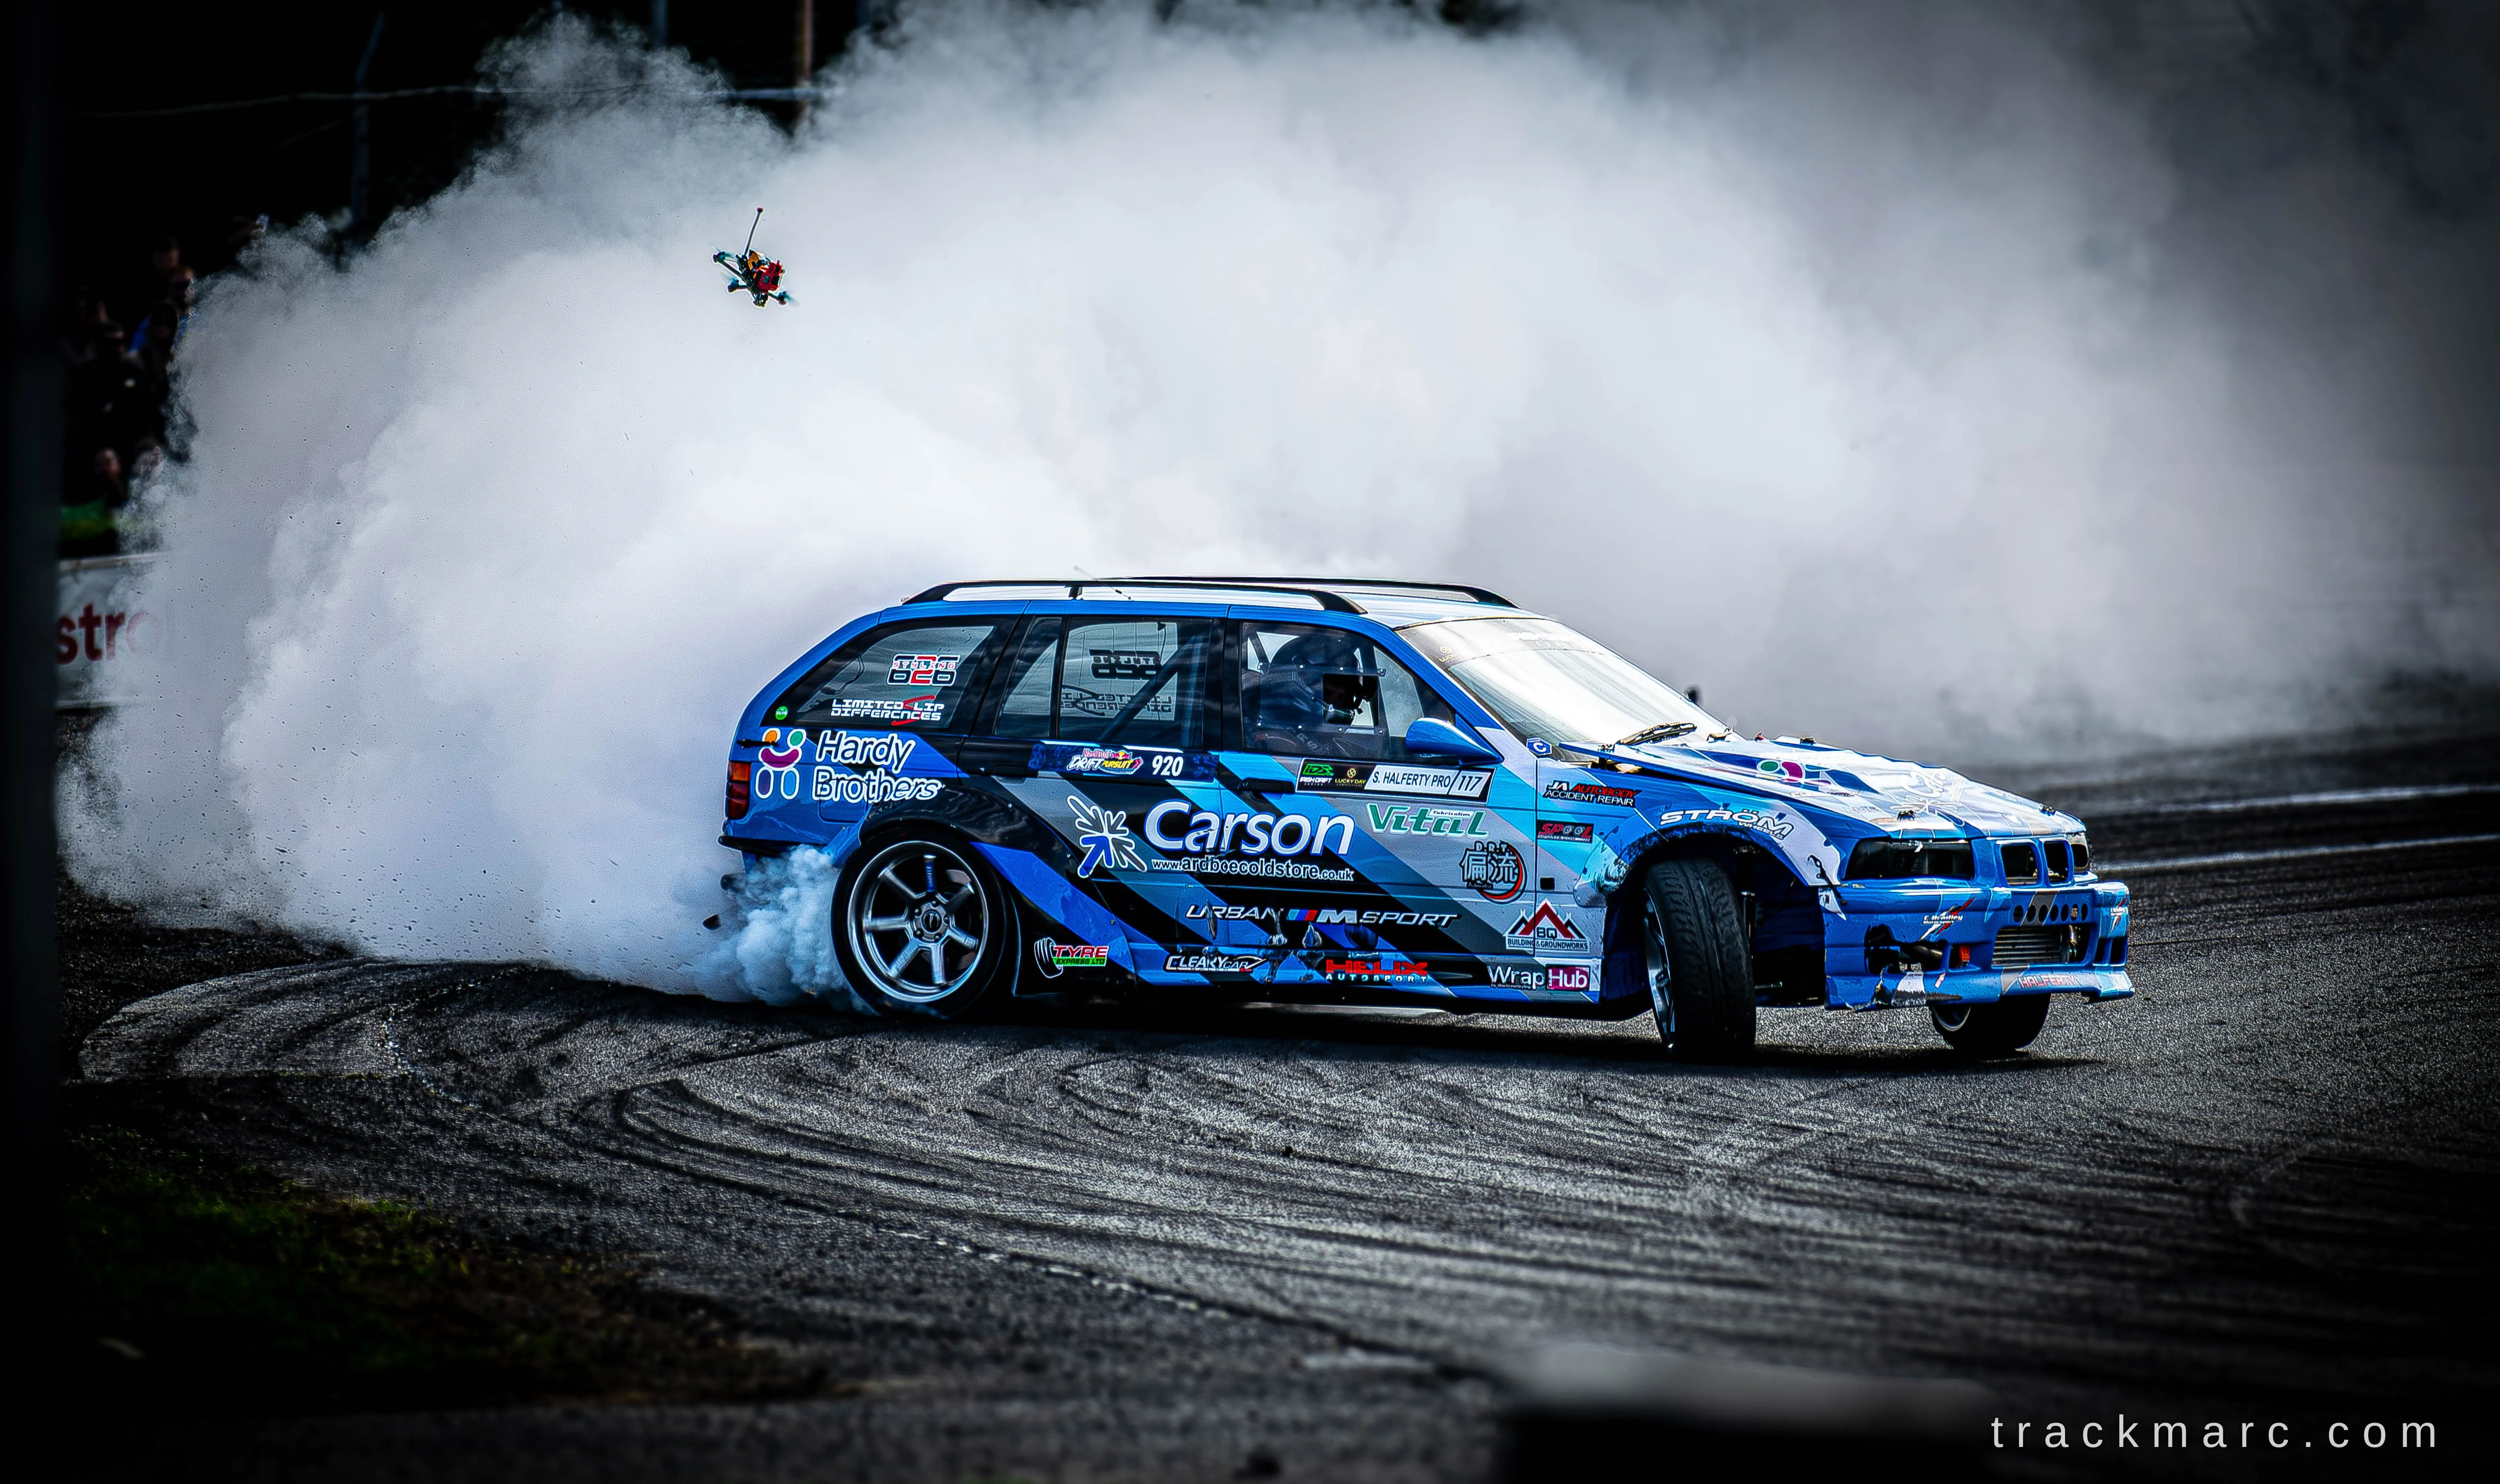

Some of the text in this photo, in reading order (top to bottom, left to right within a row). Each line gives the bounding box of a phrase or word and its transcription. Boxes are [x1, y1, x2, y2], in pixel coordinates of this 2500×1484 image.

[891, 661, 956, 670] STYLING
[832, 699, 904, 710] LIMITED
[816, 730, 916, 773] Hardy
[1068, 756, 1134, 770] DRIFT PURSUIT
[1152, 755, 1183, 776] 920
[812, 766, 943, 803] Brothers
[1372, 771, 1451, 788] S. HALFERTY PRO
[1458, 775, 1483, 792] 117
[1545, 790, 1634, 806] ACCIDENT REPAIR
[1548, 782, 1638, 798] JA AUTOBODY
[1144, 800, 1355, 856] Carson
[1367, 803, 1490, 839] Vital
[1660, 808, 1794, 836] STRÖM
[1539, 823, 1592, 839] SPOOL
[1739, 822, 1784, 840] WHEELS
[1151, 856, 1355, 881] www.ardboecoldstore.co.uk
[1461, 850, 1518, 882] 偏流
[1186, 904, 1458, 926] URBAN M SPORT
[1536, 927, 1557, 941] BQ
[1053, 946, 1109, 958] TYRE
[1508, 938, 1535, 947] BUILDING
[1540, 941, 1588, 950] GROUNDWORKS
[1326, 959, 1428, 975] HELIX
[1326, 973, 1426, 983] AUTOSPORT
[1487, 966, 1588, 989] Wrap Hub
[2018, 974, 2077, 988] HALFERTY
